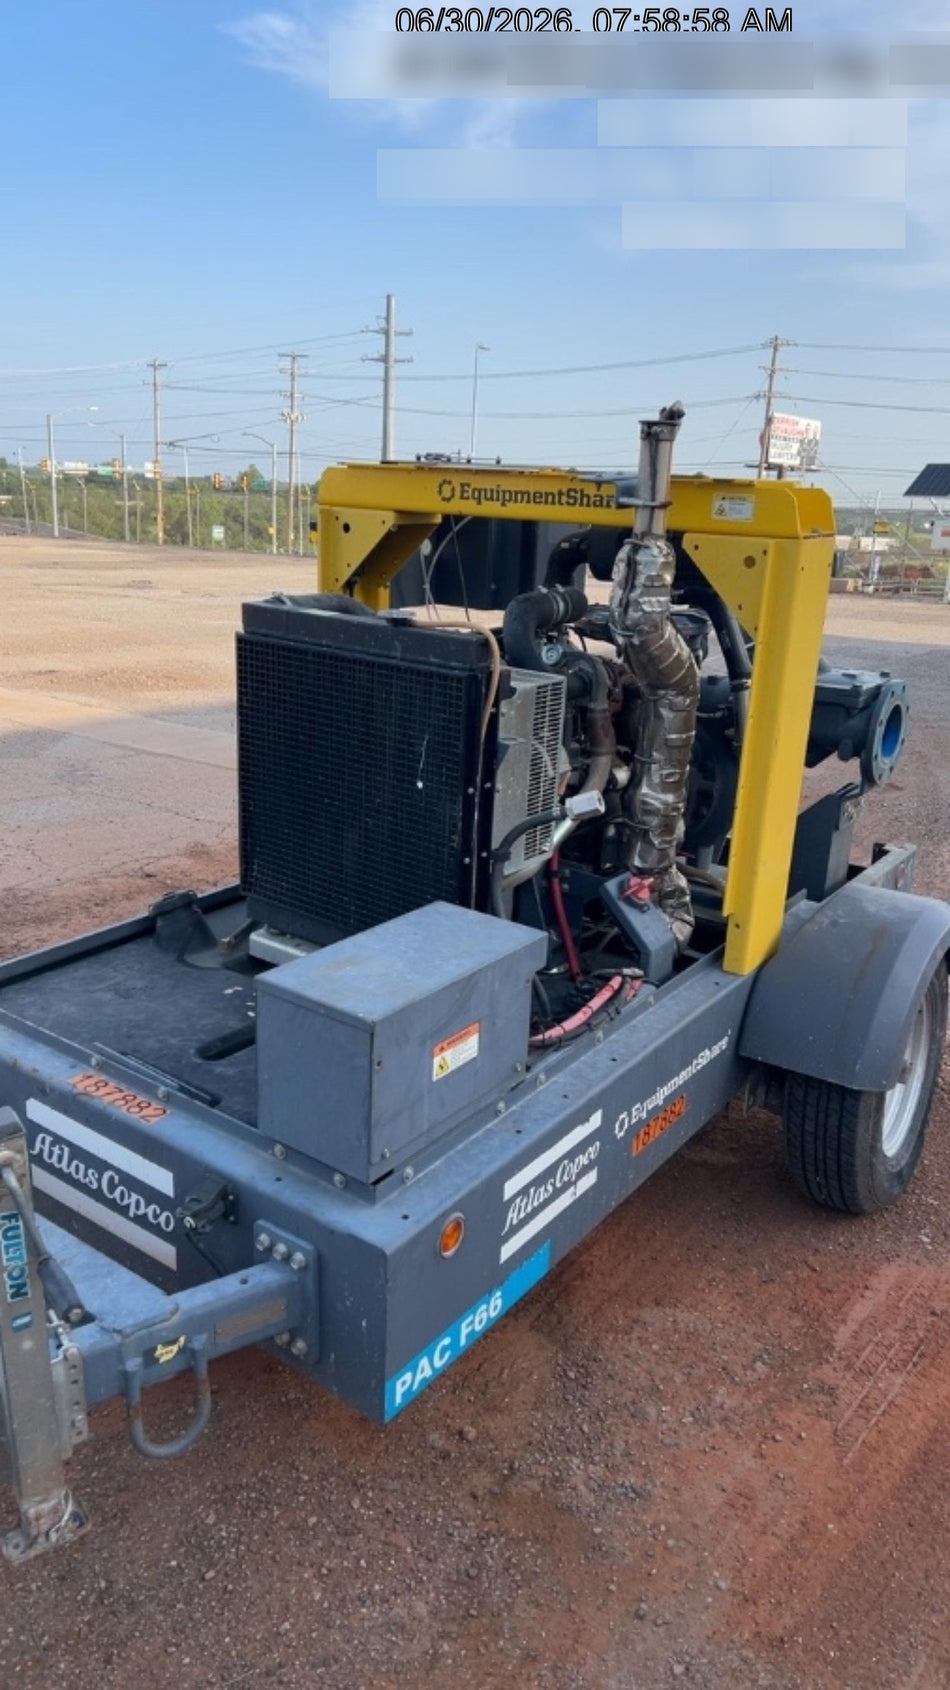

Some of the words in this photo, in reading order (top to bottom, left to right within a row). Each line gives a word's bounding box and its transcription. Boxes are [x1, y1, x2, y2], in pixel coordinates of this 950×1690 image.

[459, 483, 617, 508] EquipmentShar
[71, 1074, 168, 1122] 187882
[30, 1133, 99, 1190] Atlas
[101, 1171, 175, 1232] Copco
[501, 1177, 555, 1236] Atlas
[555, 1141, 600, 1188] Copco
[1, 1213, 29, 1300] FULTON
[395, 1336, 451, 1407] PAC
[460, 1290, 502, 1347] F66
